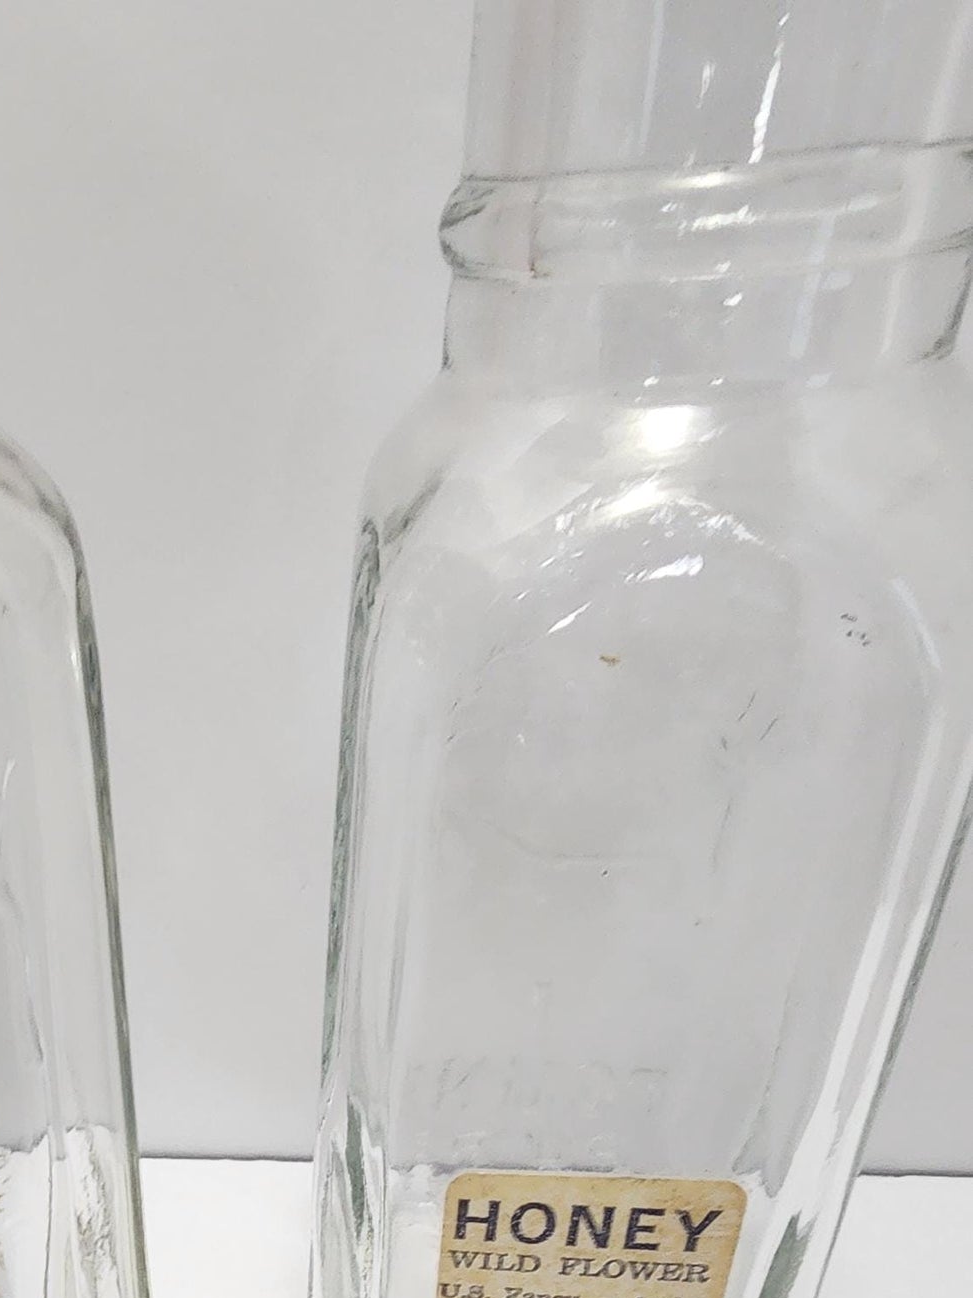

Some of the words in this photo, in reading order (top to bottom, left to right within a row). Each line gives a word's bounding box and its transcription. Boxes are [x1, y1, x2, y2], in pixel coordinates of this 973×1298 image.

[452, 1197, 724, 1253] HONEY
[447, 1250, 542, 1274] WILD
[558, 1256, 711, 1284] FLOWER
